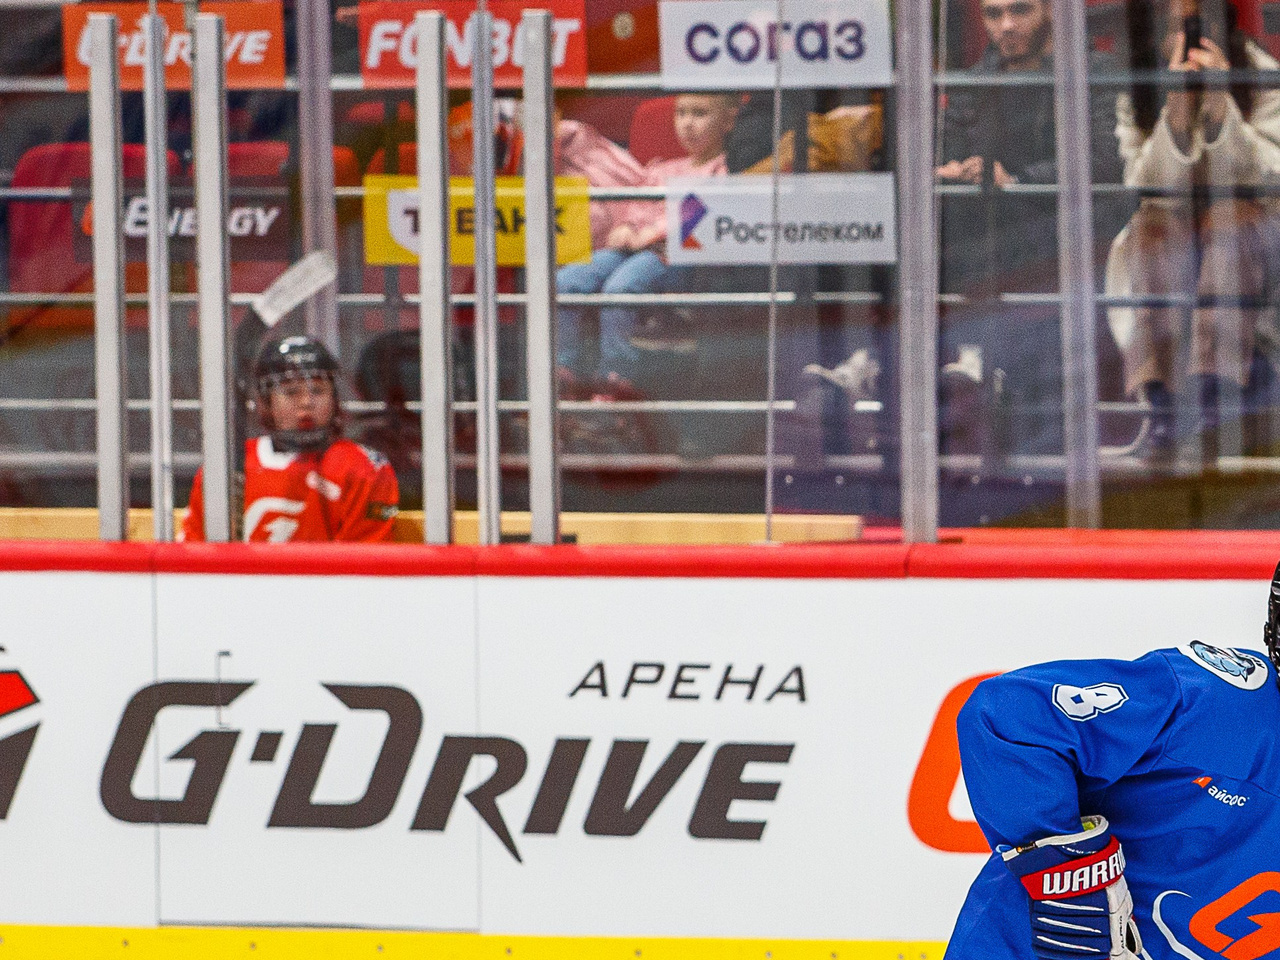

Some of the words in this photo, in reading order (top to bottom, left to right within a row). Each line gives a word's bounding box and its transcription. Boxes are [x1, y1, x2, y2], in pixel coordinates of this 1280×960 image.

[685, 20, 867, 65] согаз
[714, 215, 884, 243] Ростелеком
[568, 660, 808, 704] АРЕНА
